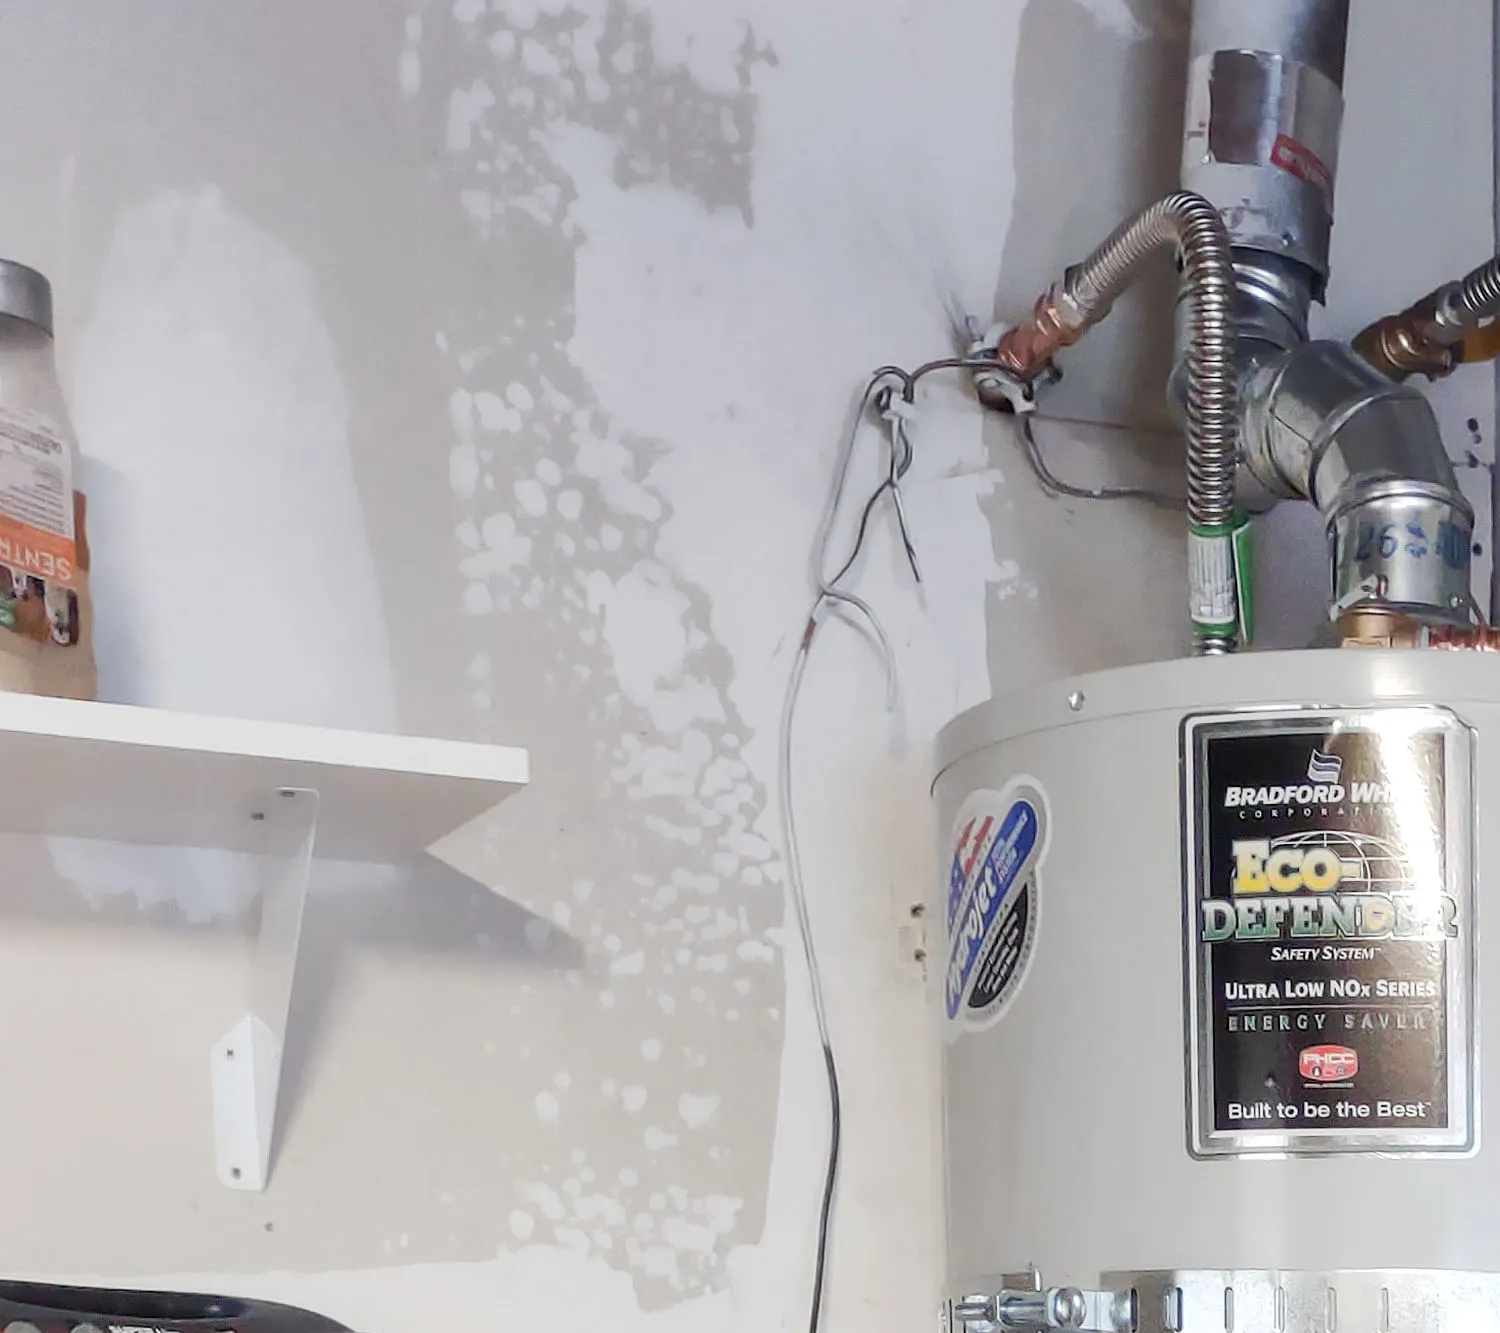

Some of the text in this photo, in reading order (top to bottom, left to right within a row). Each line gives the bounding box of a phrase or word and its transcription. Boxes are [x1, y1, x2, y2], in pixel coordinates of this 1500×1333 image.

[1224, 783, 1346, 808] BRADFORD
[1238, 807, 1406, 821] CORPORATI
[1270, 946, 1321, 962] SAFETY
[1225, 982, 1280, 1001] ULTRA
[1284, 979, 1325, 998] LOW
[1375, 978, 1437, 998] SERIES
[1228, 1012, 1427, 1032] ENERGY SAVER
[1228, 1102, 1273, 1120] Built
[1276, 1102, 1299, 1119] to
[1303, 1100, 1331, 1119] be
[1335, 1101, 1371, 1118] the
